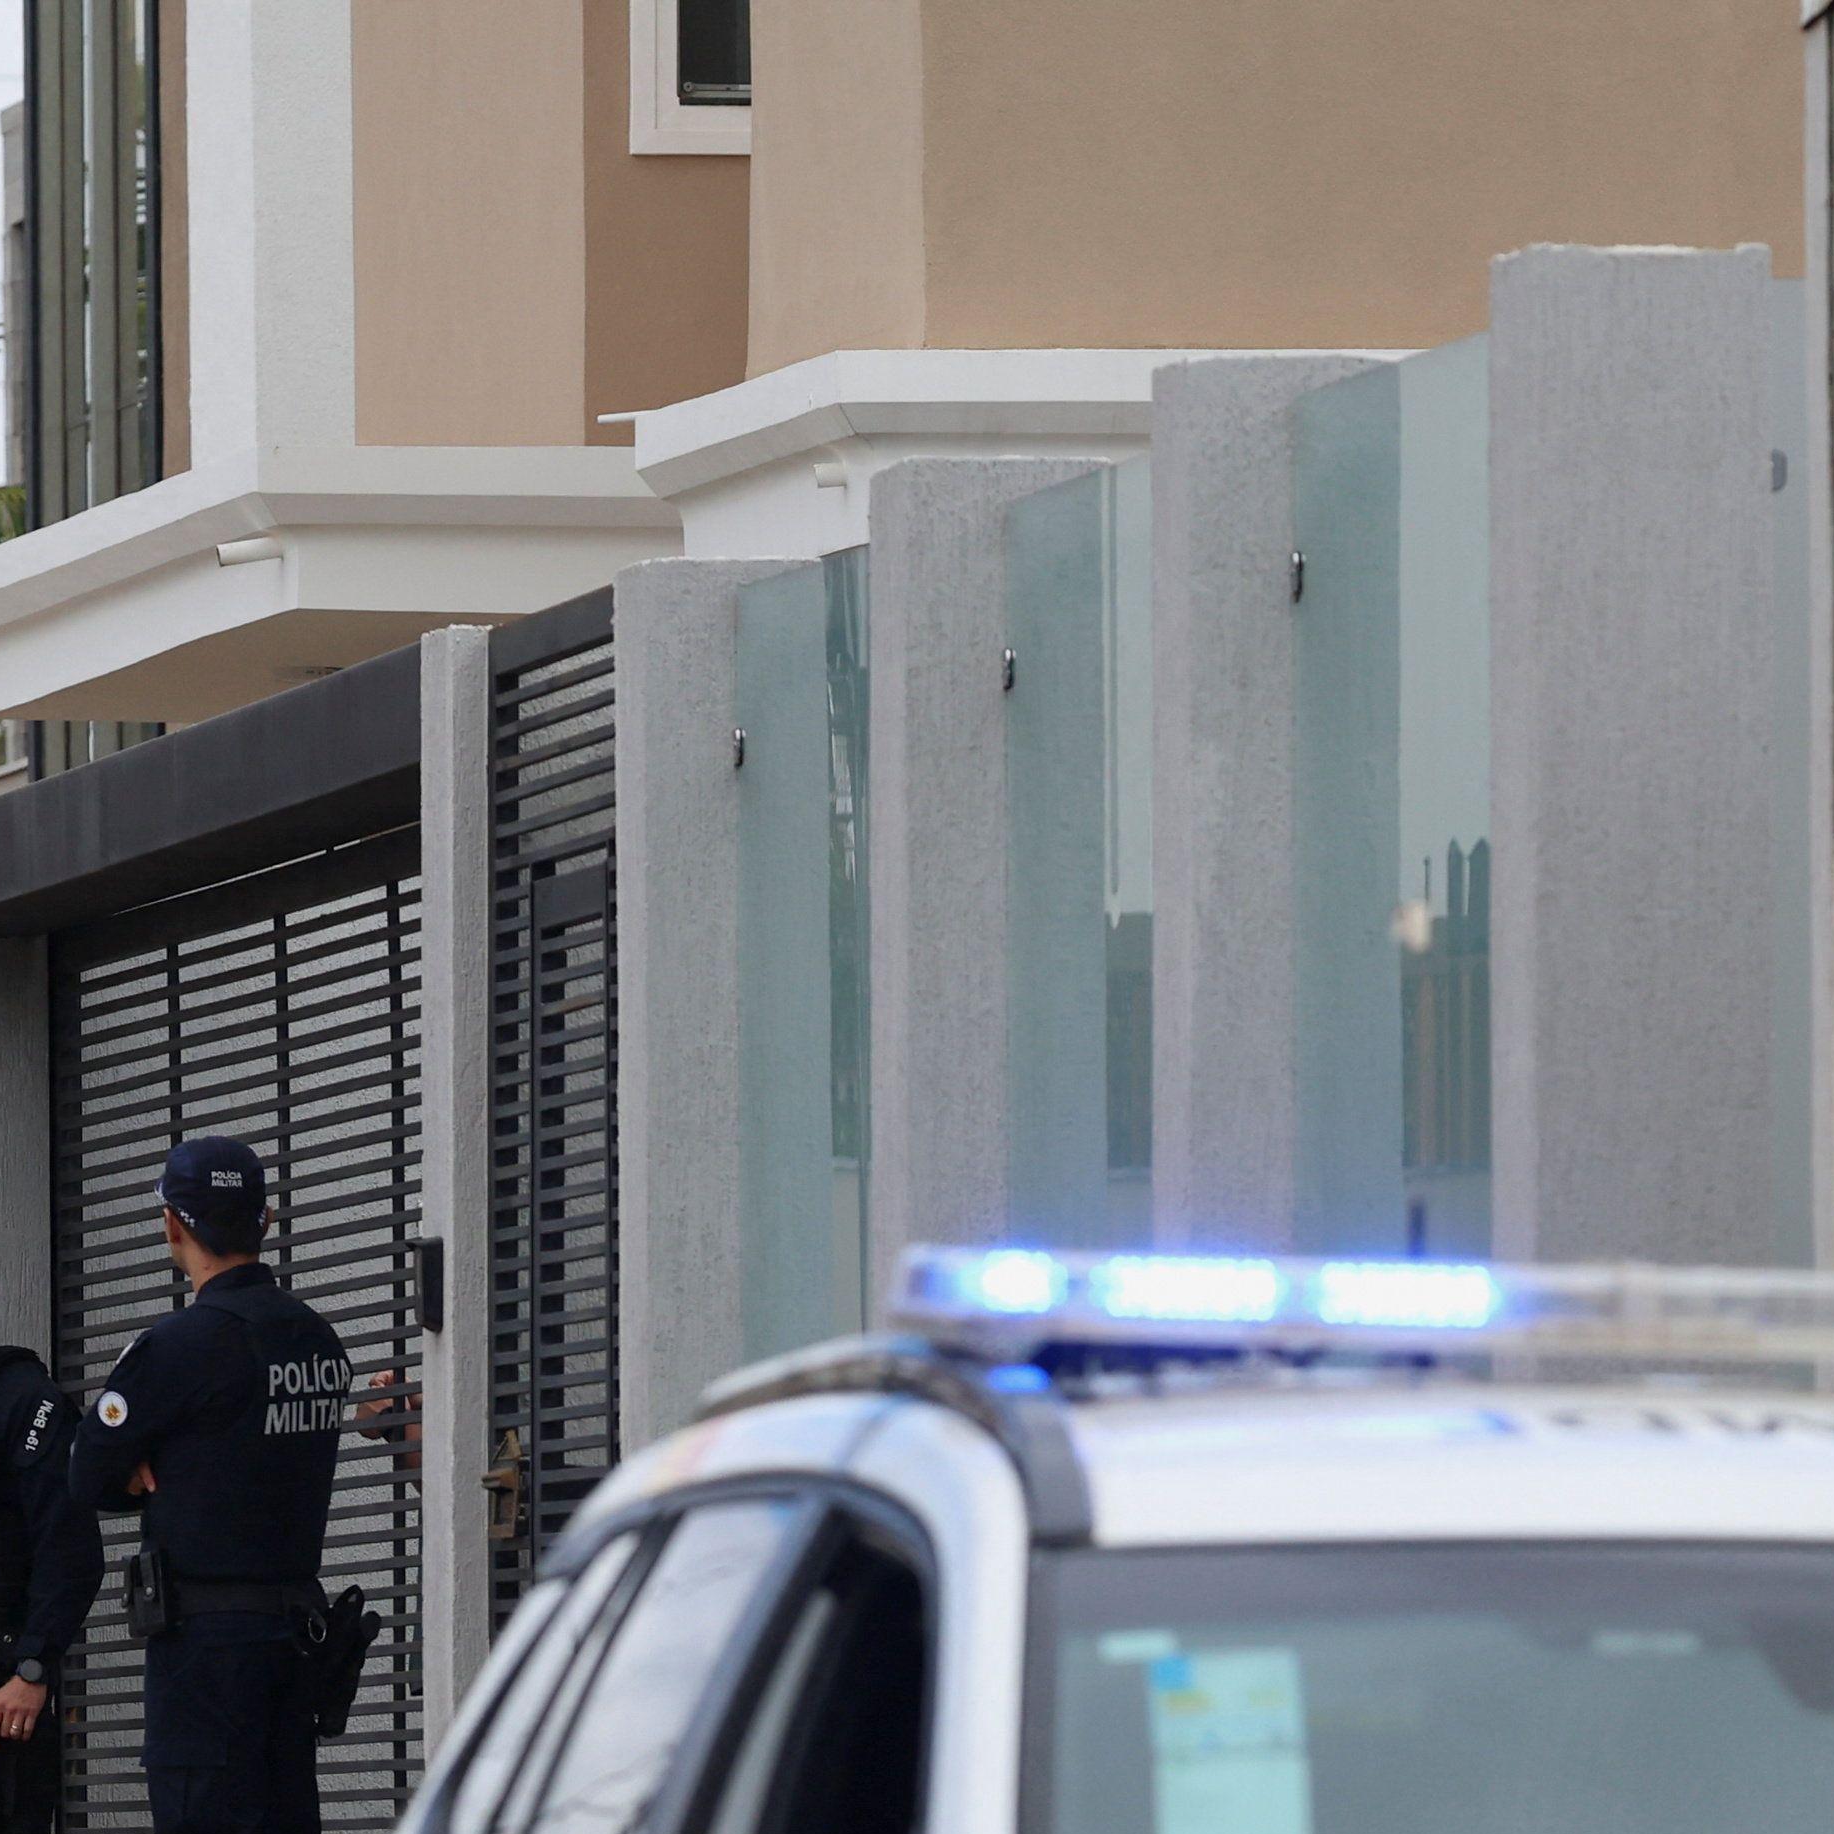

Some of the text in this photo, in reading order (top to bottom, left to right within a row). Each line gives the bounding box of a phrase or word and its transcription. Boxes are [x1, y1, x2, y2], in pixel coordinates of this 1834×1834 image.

[211, 1179, 243, 1188] MILITAR
[268, 1353, 351, 1397] POLÍCIA
[33, 1399, 55, 1429] BPM
